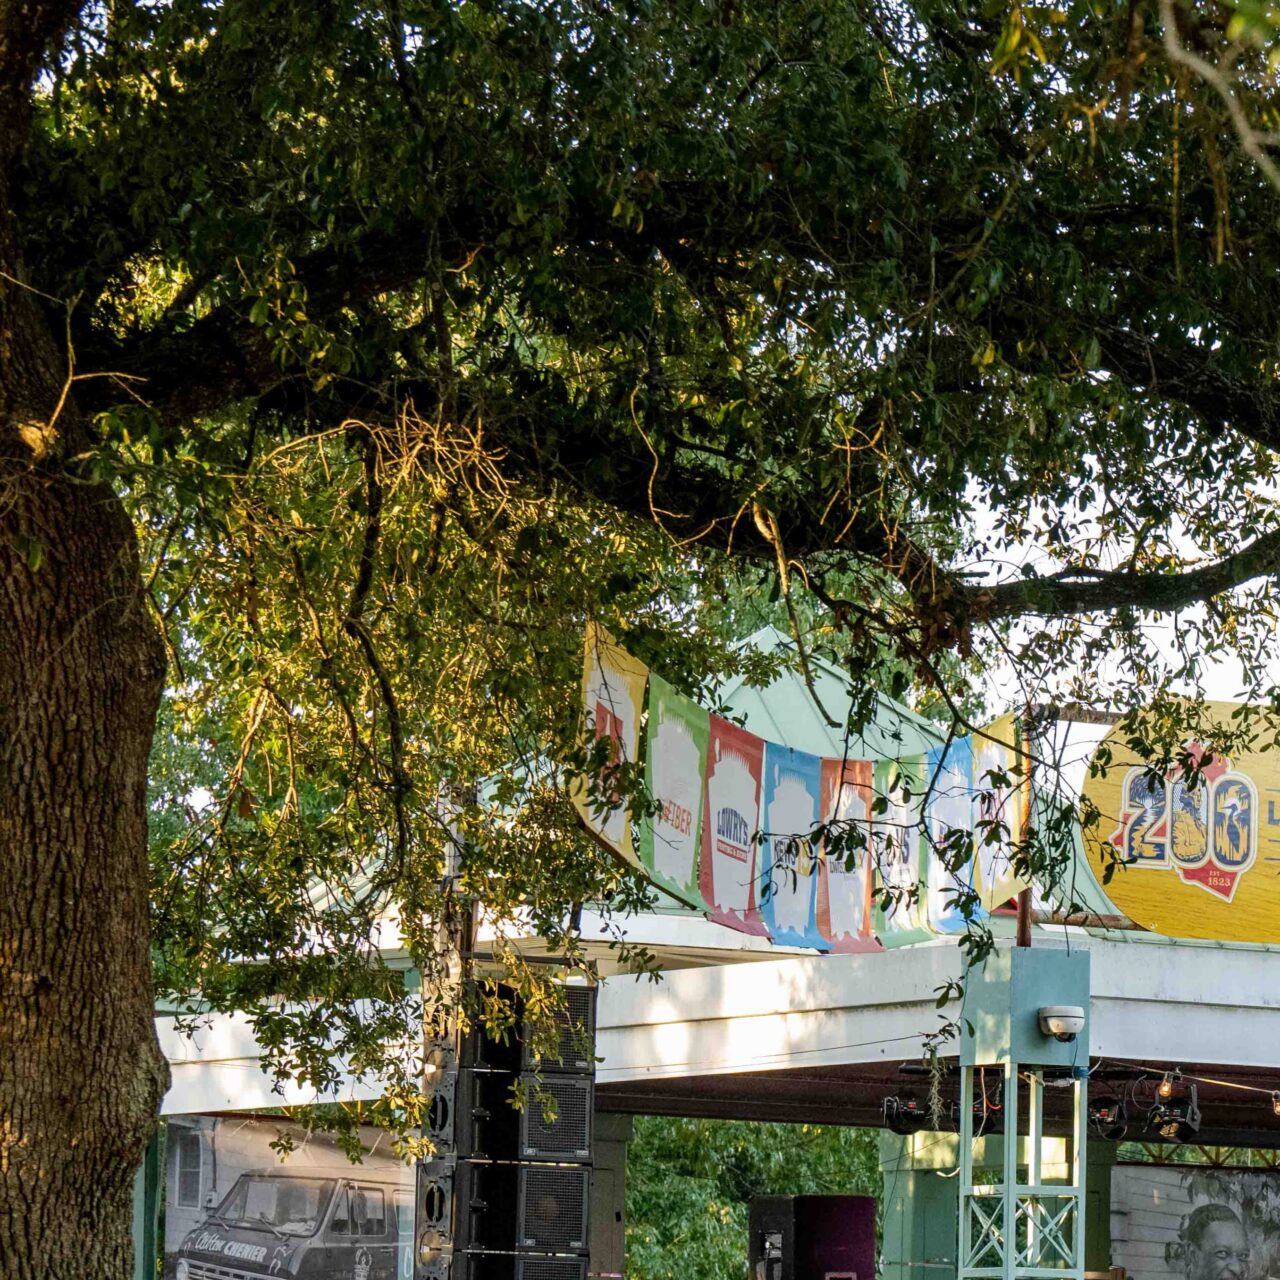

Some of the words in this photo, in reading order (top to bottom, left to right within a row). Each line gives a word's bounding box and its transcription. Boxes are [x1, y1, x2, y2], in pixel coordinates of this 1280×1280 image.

[1122, 767, 1258, 871] 200
[1208, 876, 1231, 887] 1823
[224, 1241, 267, 1262] CHENIER
